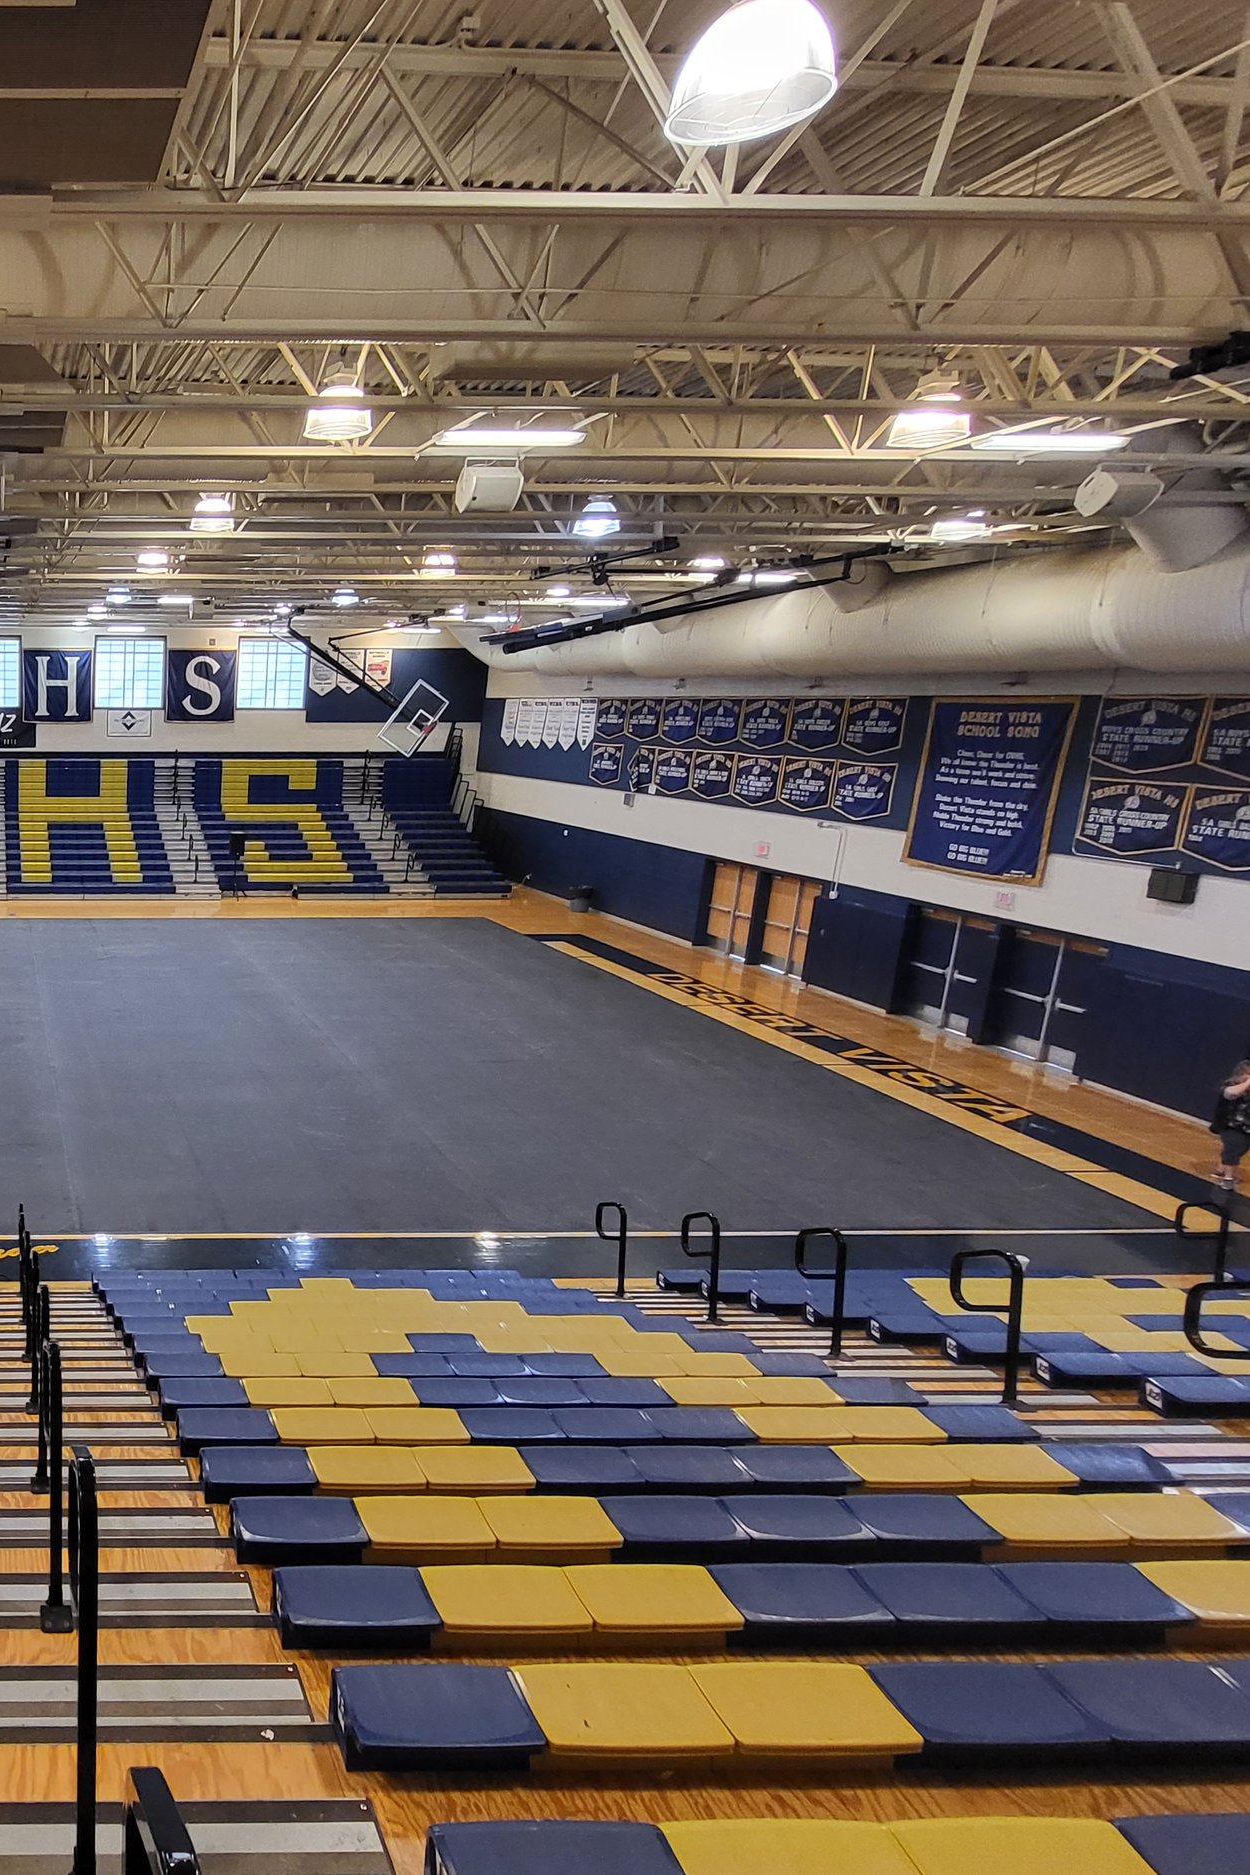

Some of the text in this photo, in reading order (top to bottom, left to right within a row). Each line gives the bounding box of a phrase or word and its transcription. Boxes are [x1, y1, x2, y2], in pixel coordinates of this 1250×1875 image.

[34, 655, 80, 717] H
[181, 655, 221, 716] S
[1104, 701, 1146, 718] DESERT
[960, 711, 1041, 724] DESERT VISTA
[957, 725, 1039, 737] SCHOOL SONG
[1152, 728, 1189, 736] COUNTRY
[1102, 734, 1129, 742] STATE
[1213, 737, 1241, 747] STATE
[1134, 785, 1162, 800] VISTA
[1196, 793, 1243, 810] DESERT
[1119, 810, 1140, 818] CROSS
[1141, 812, 1170, 820] COUNTRY
[1088, 815, 1168, 829] STATE RUNNER-UP
[1193, 825, 1223, 837] STATE
[647, 973, 1033, 1123] DESERT VISTA
